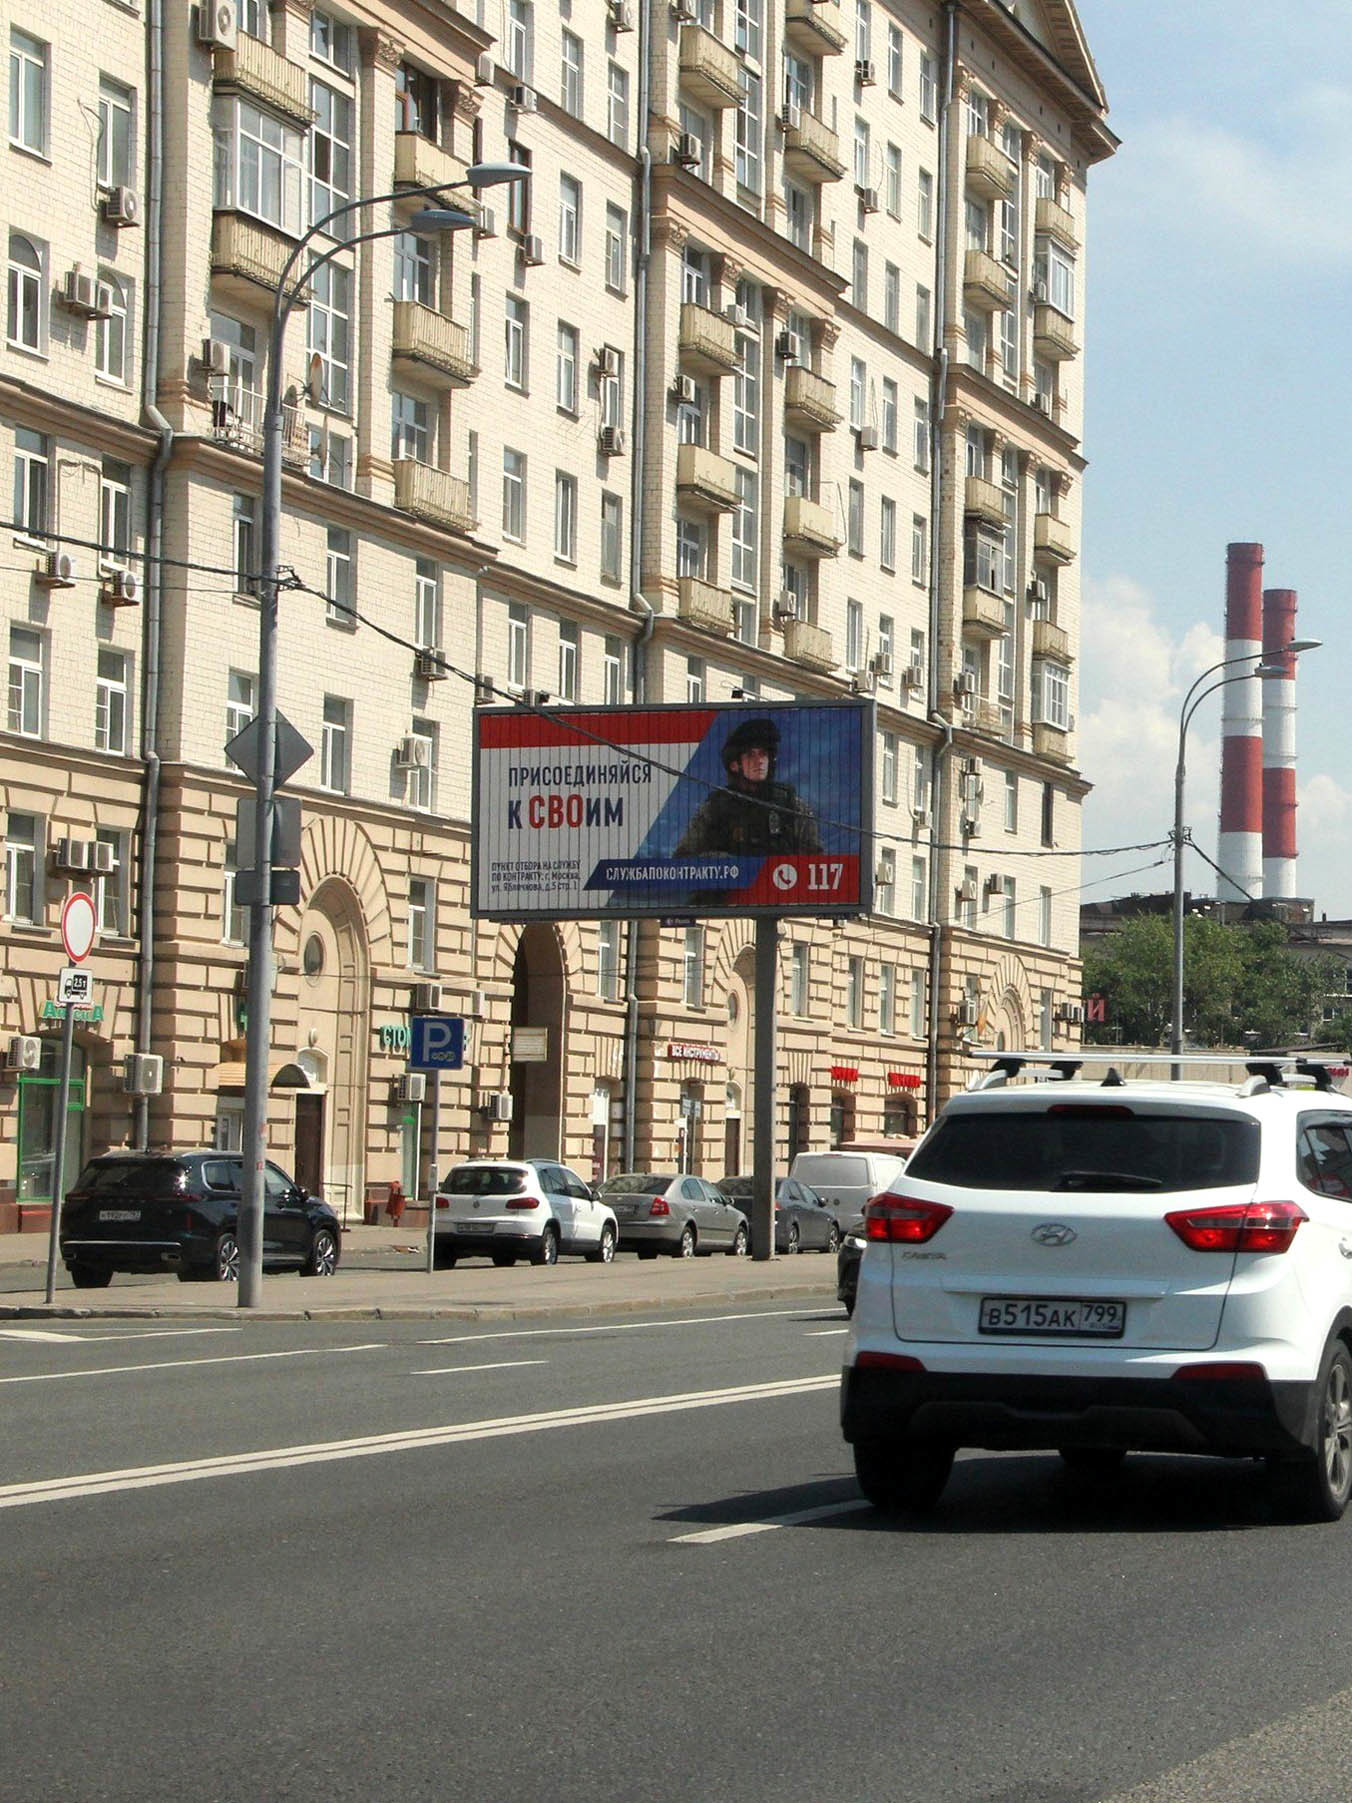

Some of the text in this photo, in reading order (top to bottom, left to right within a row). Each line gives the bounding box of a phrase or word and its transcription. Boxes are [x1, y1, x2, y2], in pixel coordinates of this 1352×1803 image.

[508, 760, 651, 787] ПРИСОЕДИНЯЙСЯ
[508, 794, 624, 829] К СВОИМ
[515, 861, 541, 871] ОТБОРА
[543, 861, 552, 870] НА
[552, 860, 580, 870] СЛУЖБУ
[605, 865, 740, 881] СЛУЖБАПОКОНТРАКТУ.РФ
[491, 872, 502, 882] ПО
[807, 863, 844, 890] 117
[1084, 1304, 1117, 1323] 799
